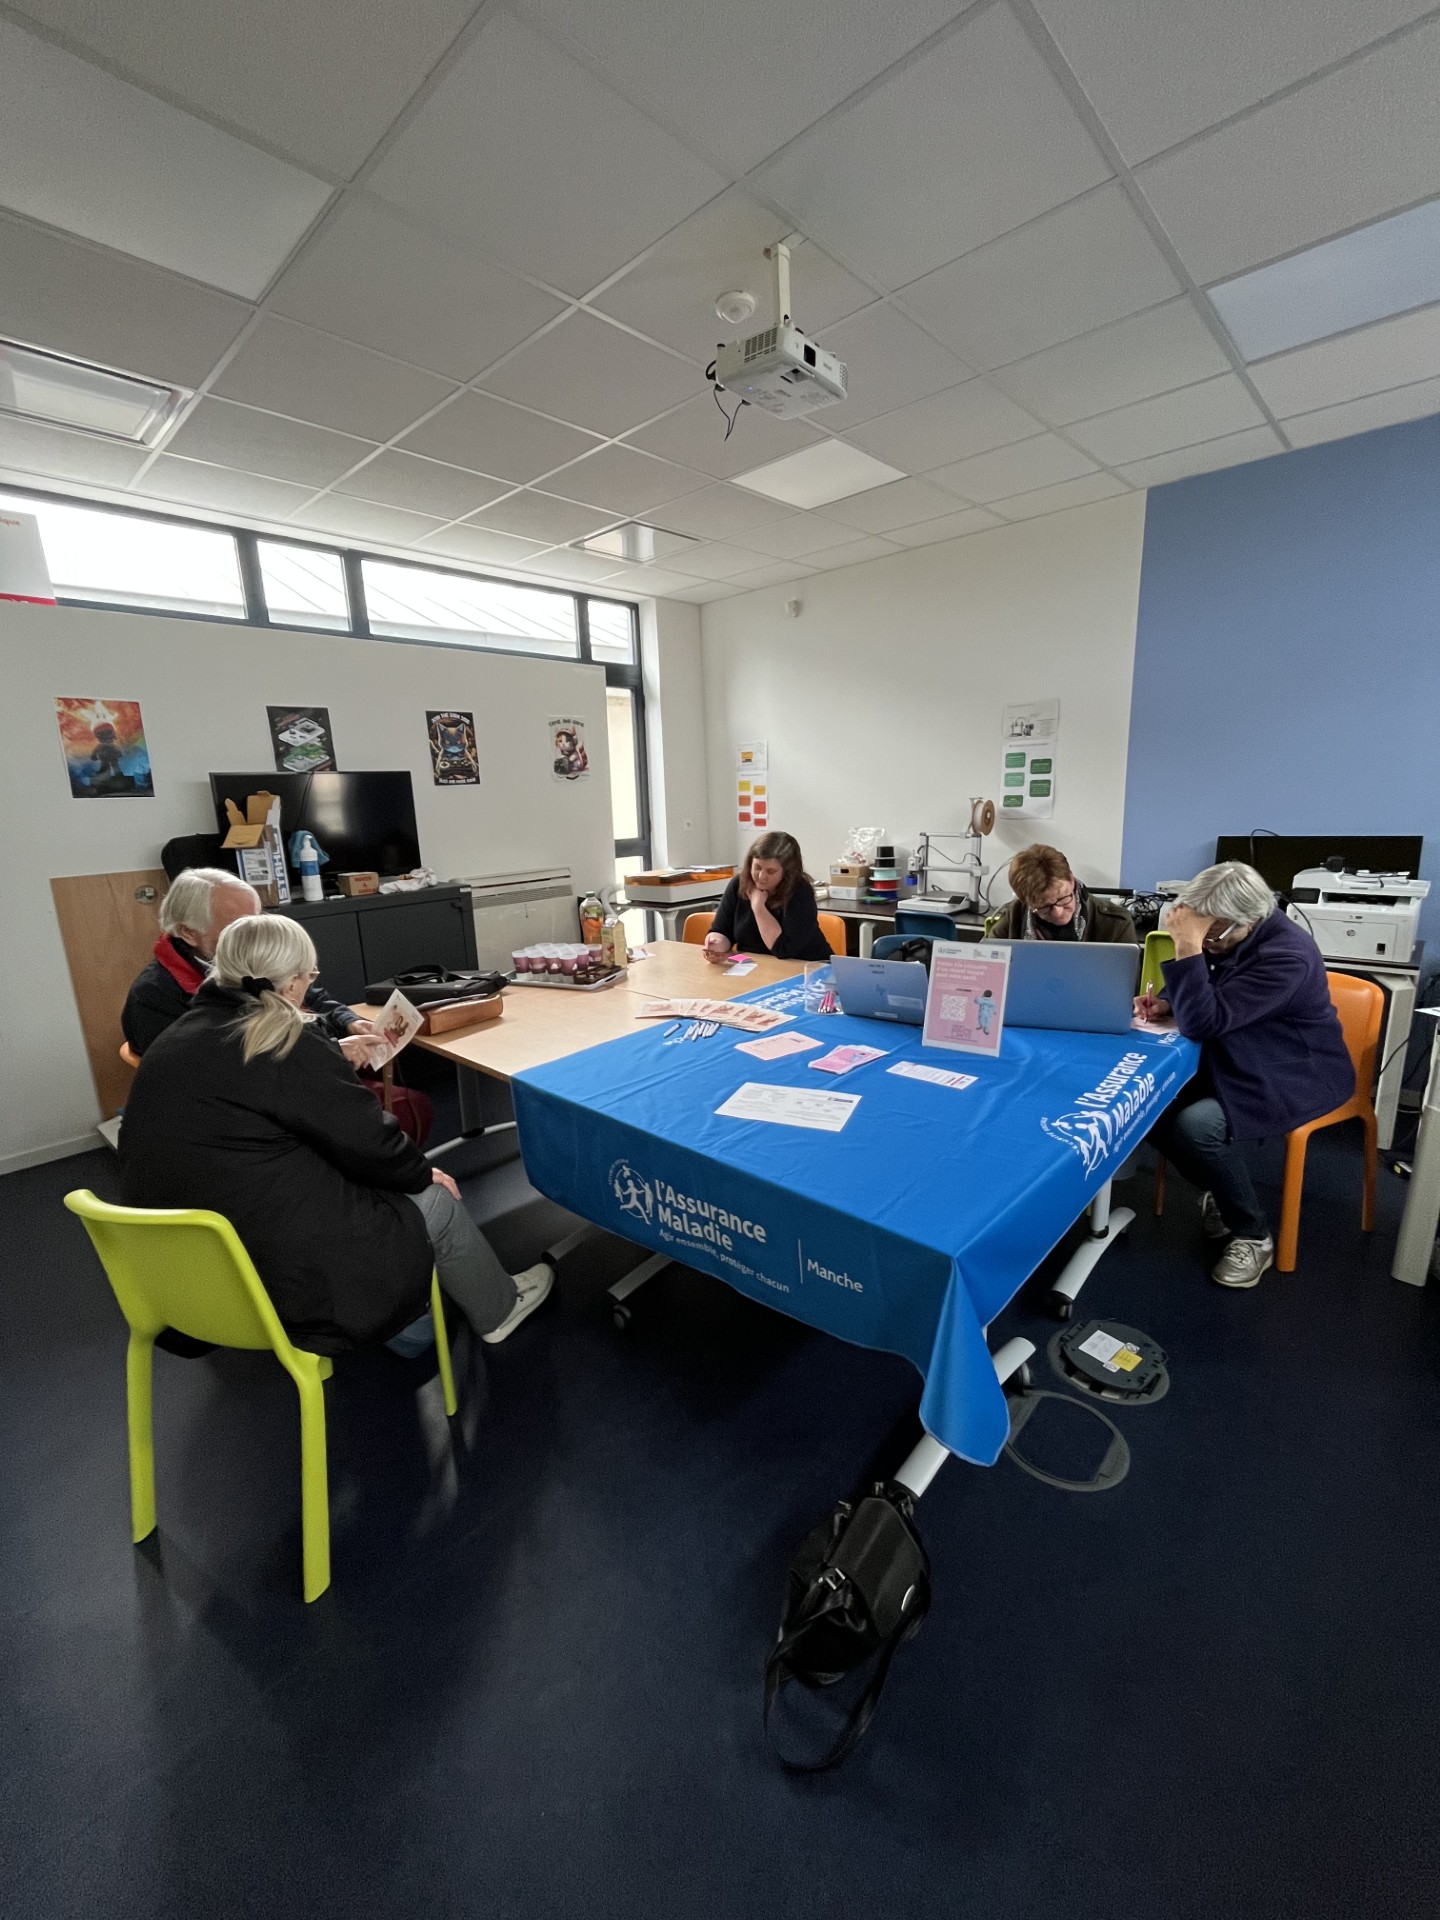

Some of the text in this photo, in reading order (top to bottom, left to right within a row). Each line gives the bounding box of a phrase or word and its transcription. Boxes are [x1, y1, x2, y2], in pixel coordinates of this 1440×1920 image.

[1074, 1052, 1148, 1108] l'Assurance
[1112, 1072, 1155, 1135] Maladie
[655, 1179, 767, 1243] l'Assurance
[658, 1204, 733, 1251] Maladie
[756, 1272, 790, 1293] chacun
[806, 1258, 864, 1293] Manche
